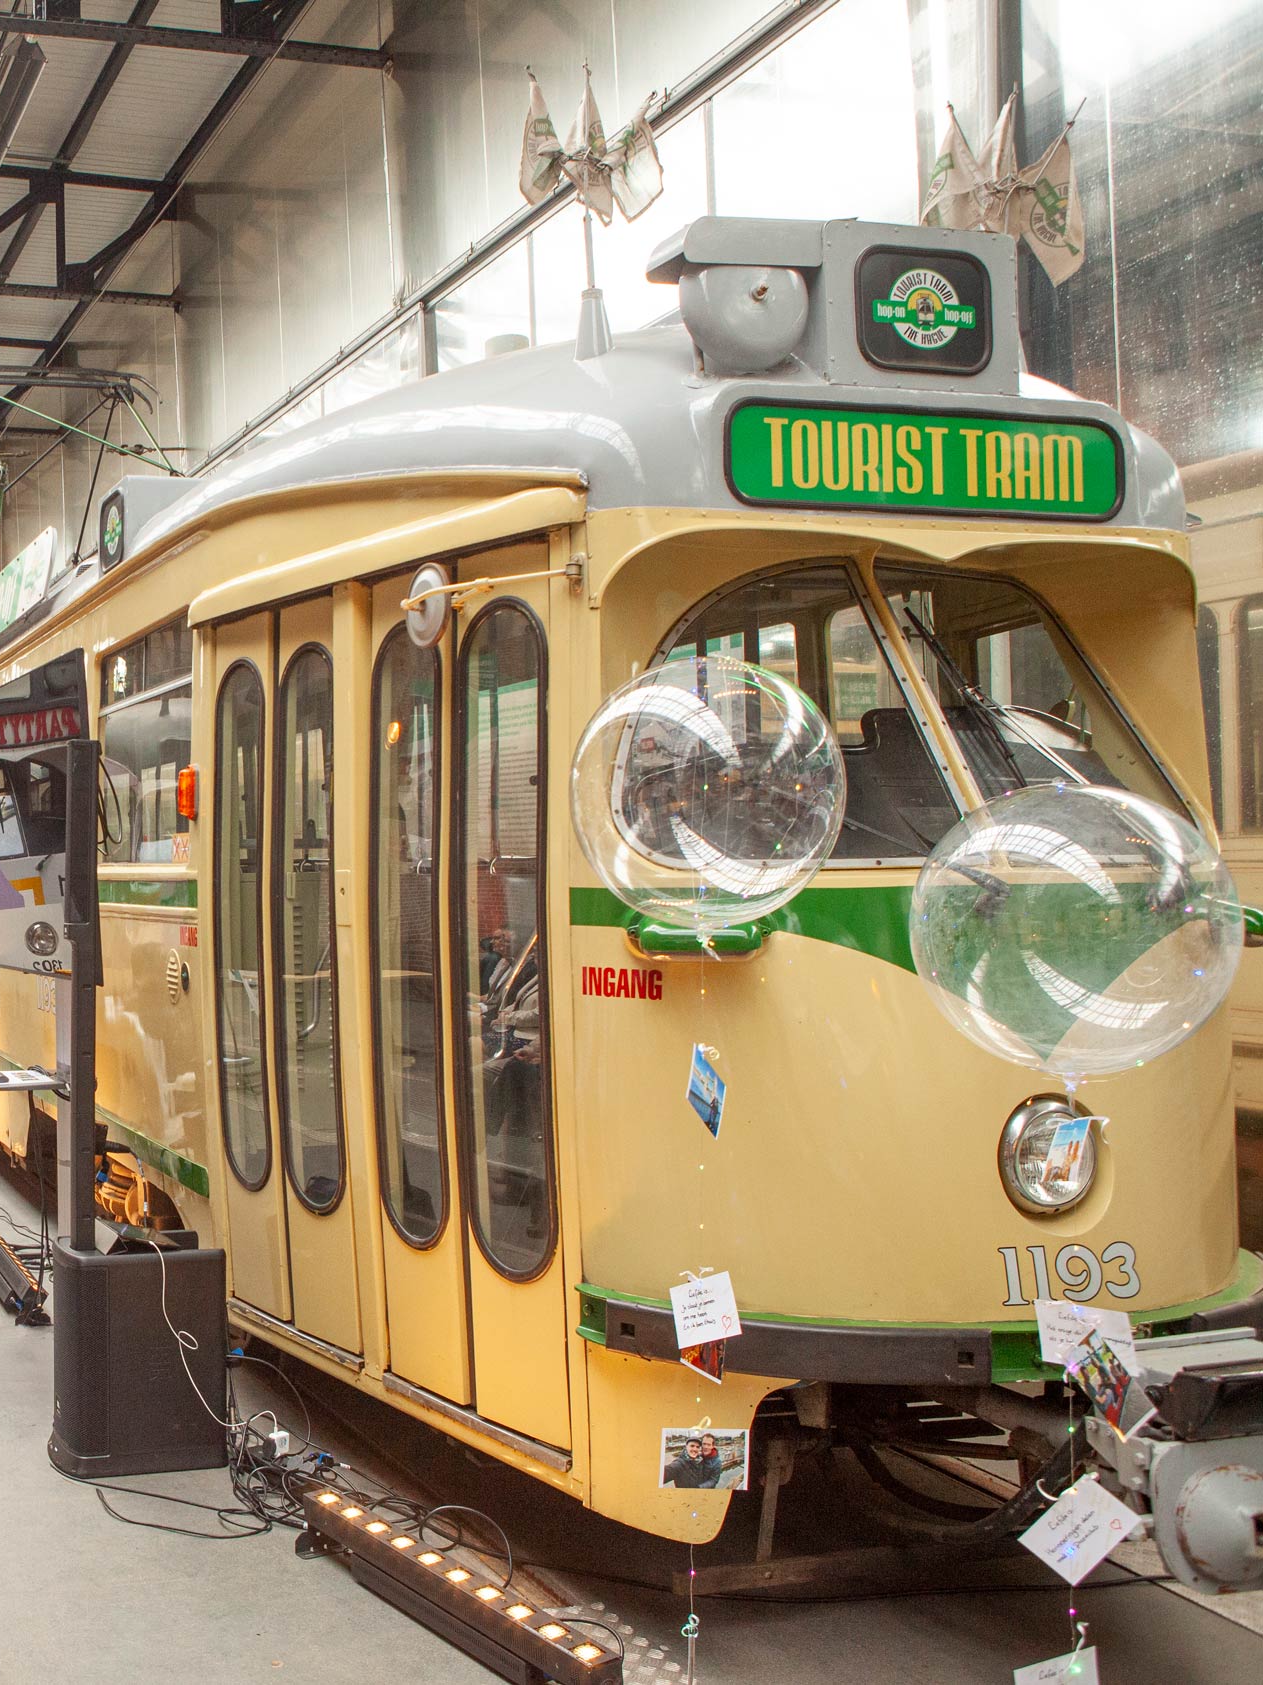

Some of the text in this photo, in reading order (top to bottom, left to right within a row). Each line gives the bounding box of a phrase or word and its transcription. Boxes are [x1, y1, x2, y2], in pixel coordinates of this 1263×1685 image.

[893, 272, 954, 303] TOURIST TRAM
[877, 303, 906, 319] hop-on
[944, 308, 973, 325] hop-off
[903, 326, 949, 346] THE HAGUE
[763, 417, 1084, 503] TOURIST TRAM
[581, 966, 663, 1001] INGANG
[997, 1241, 1142, 1307] 1193
